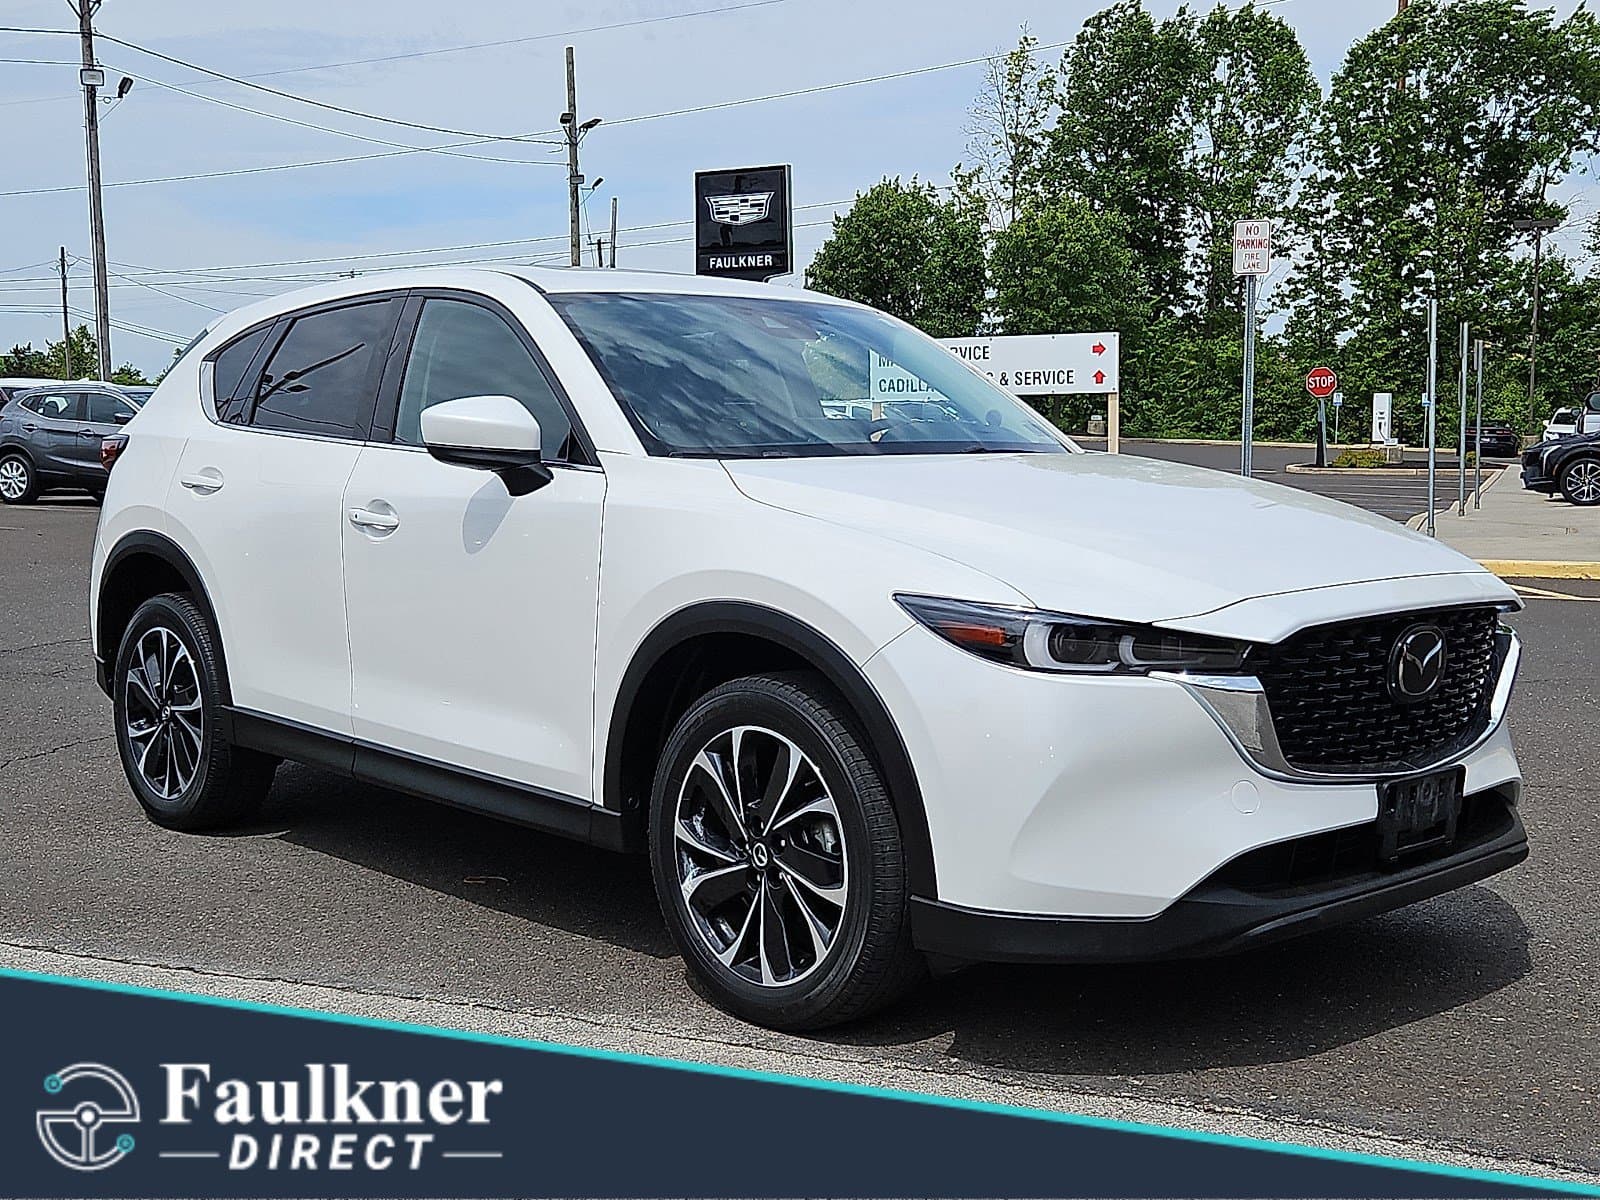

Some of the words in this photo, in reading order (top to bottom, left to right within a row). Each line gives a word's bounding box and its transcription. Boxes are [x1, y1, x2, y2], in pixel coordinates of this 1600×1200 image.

[1246, 225, 1260, 236] NO
[1236, 238, 1268, 249] PARKING
[709, 254, 773, 269] FAULKNER
[1244, 252, 1260, 261] FIRE
[1242, 261, 1261, 270] LANE
[1000, 372, 1009, 386] &
[1014, 369, 1075, 386] SERVICE
[1308, 375, 1335, 389] STOP
